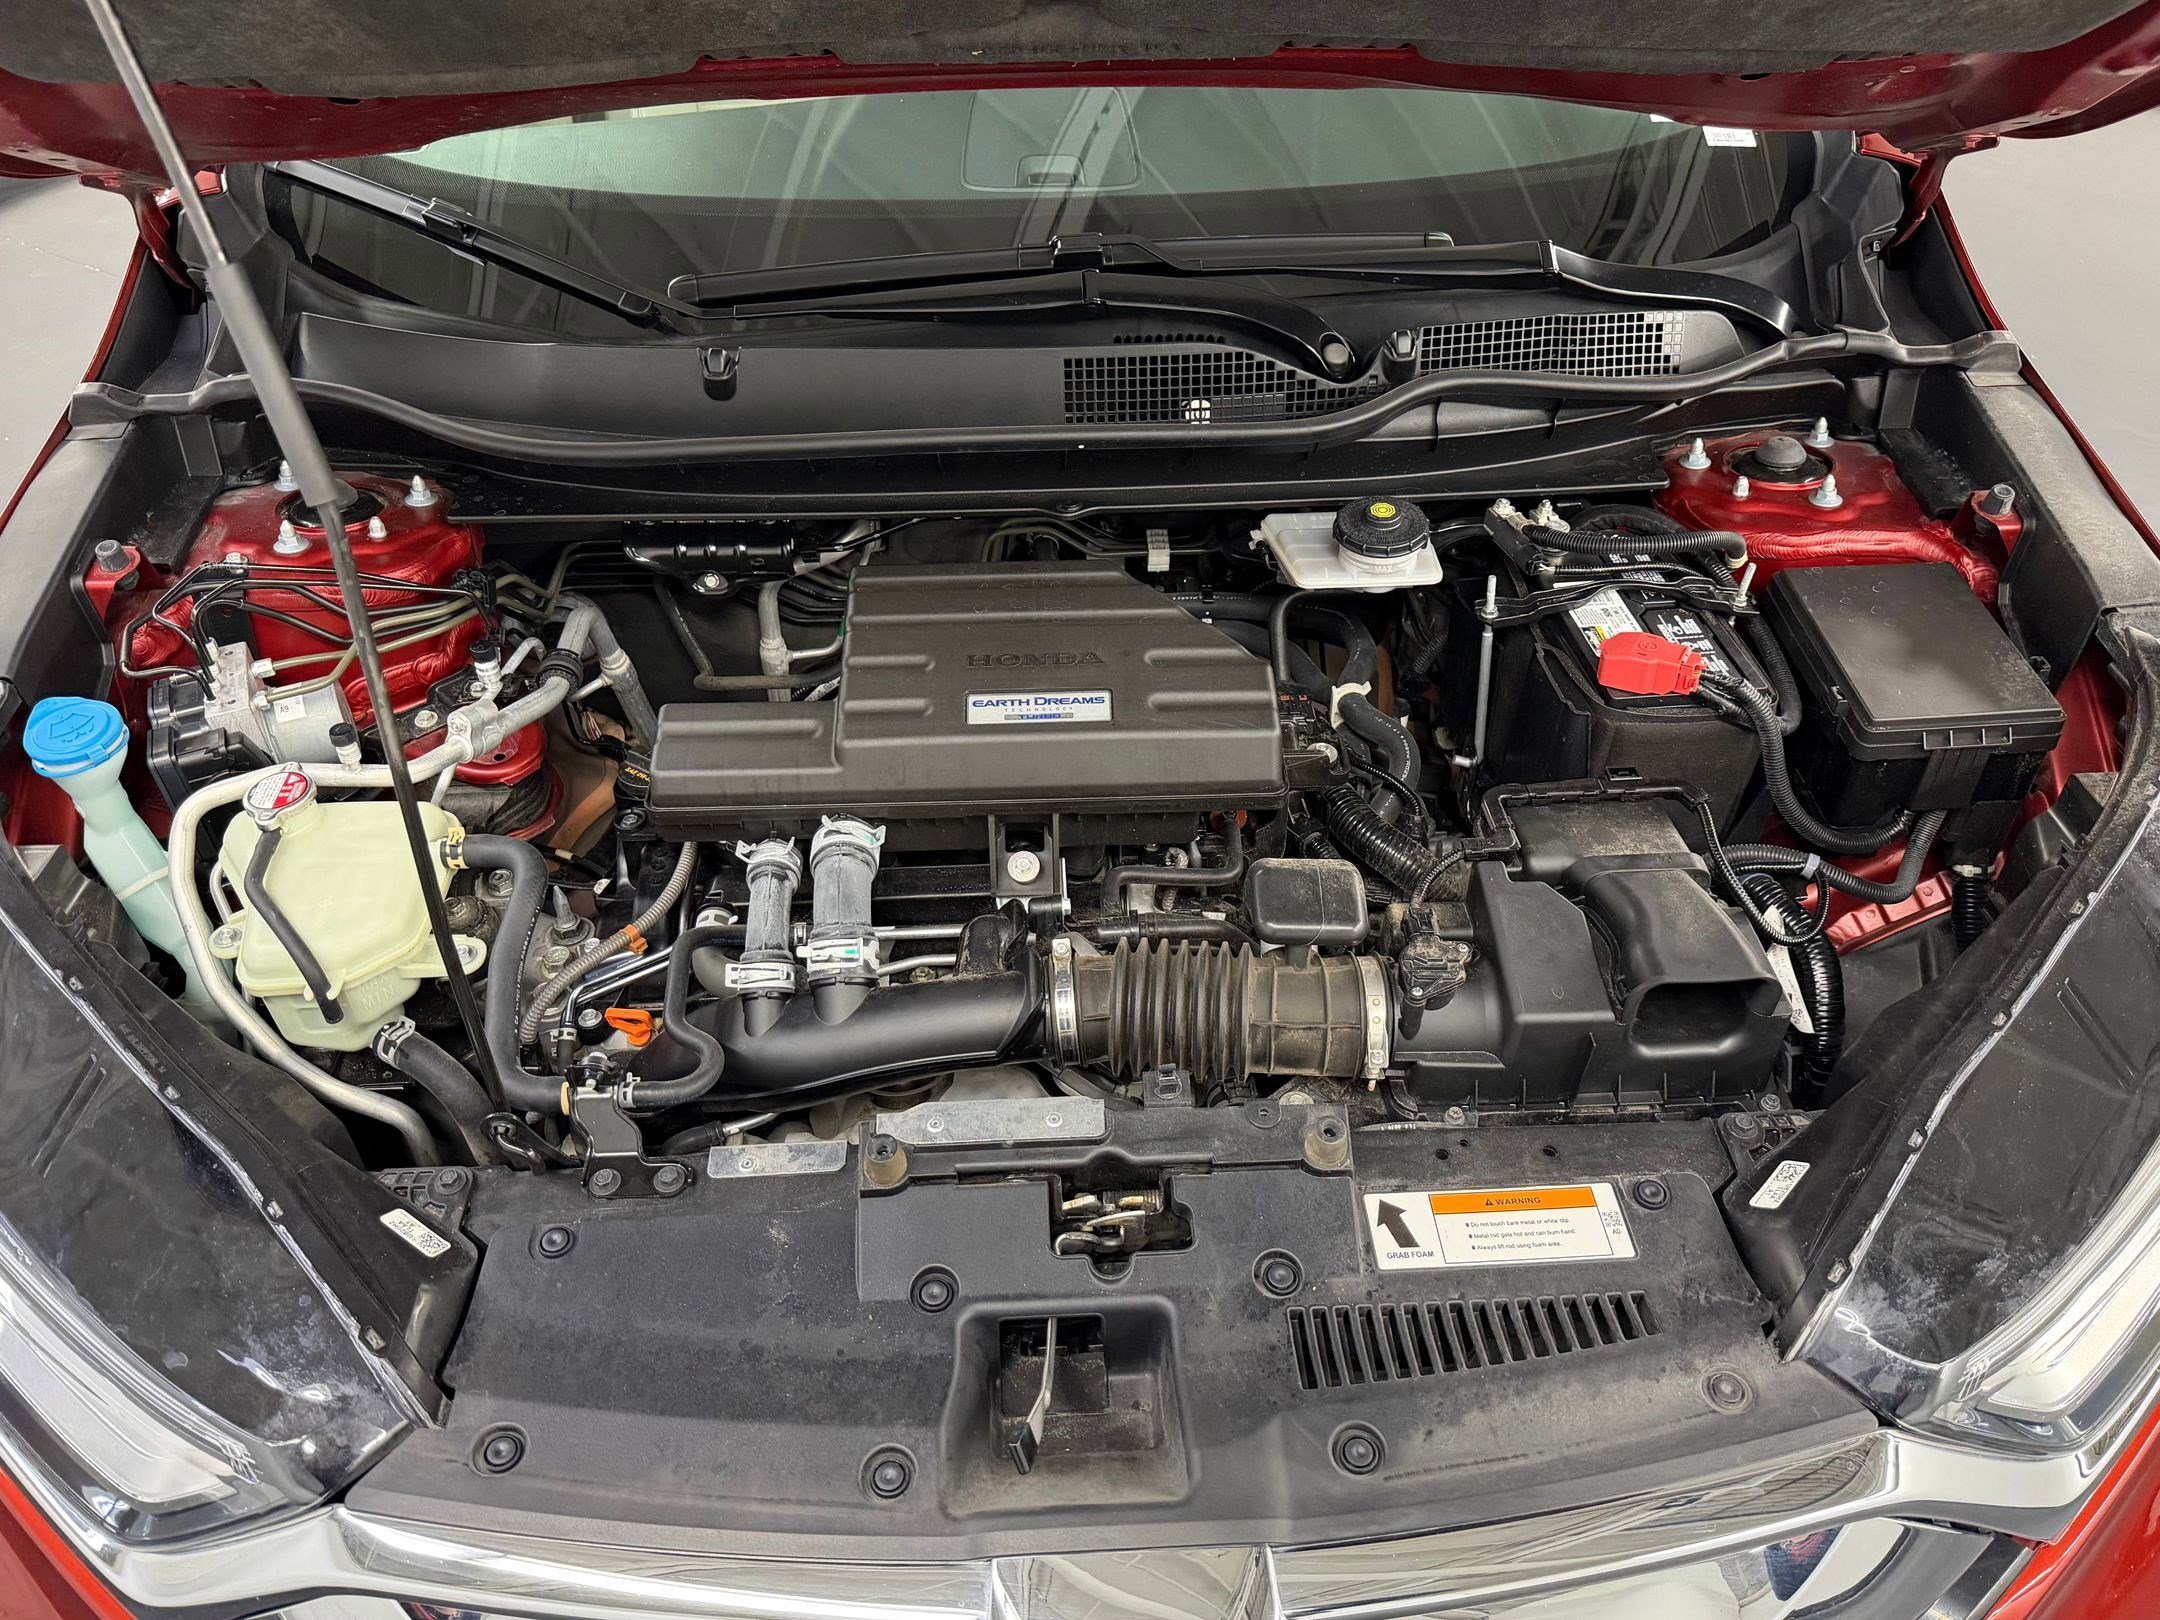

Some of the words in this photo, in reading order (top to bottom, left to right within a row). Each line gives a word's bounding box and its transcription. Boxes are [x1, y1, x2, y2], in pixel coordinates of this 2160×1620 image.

[965, 651, 1105, 668] HONDA
[972, 698, 1030, 708] EARTH
[1033, 696, 1105, 706] DREAMS
[361, 983, 396, 1011] MIN
[1495, 1196, 1542, 1206] WARNING
[1516, 1242, 1532, 1250] using
[1386, 1250, 1410, 1260] GRAB
[1411, 1250, 1435, 1259] FOAM
